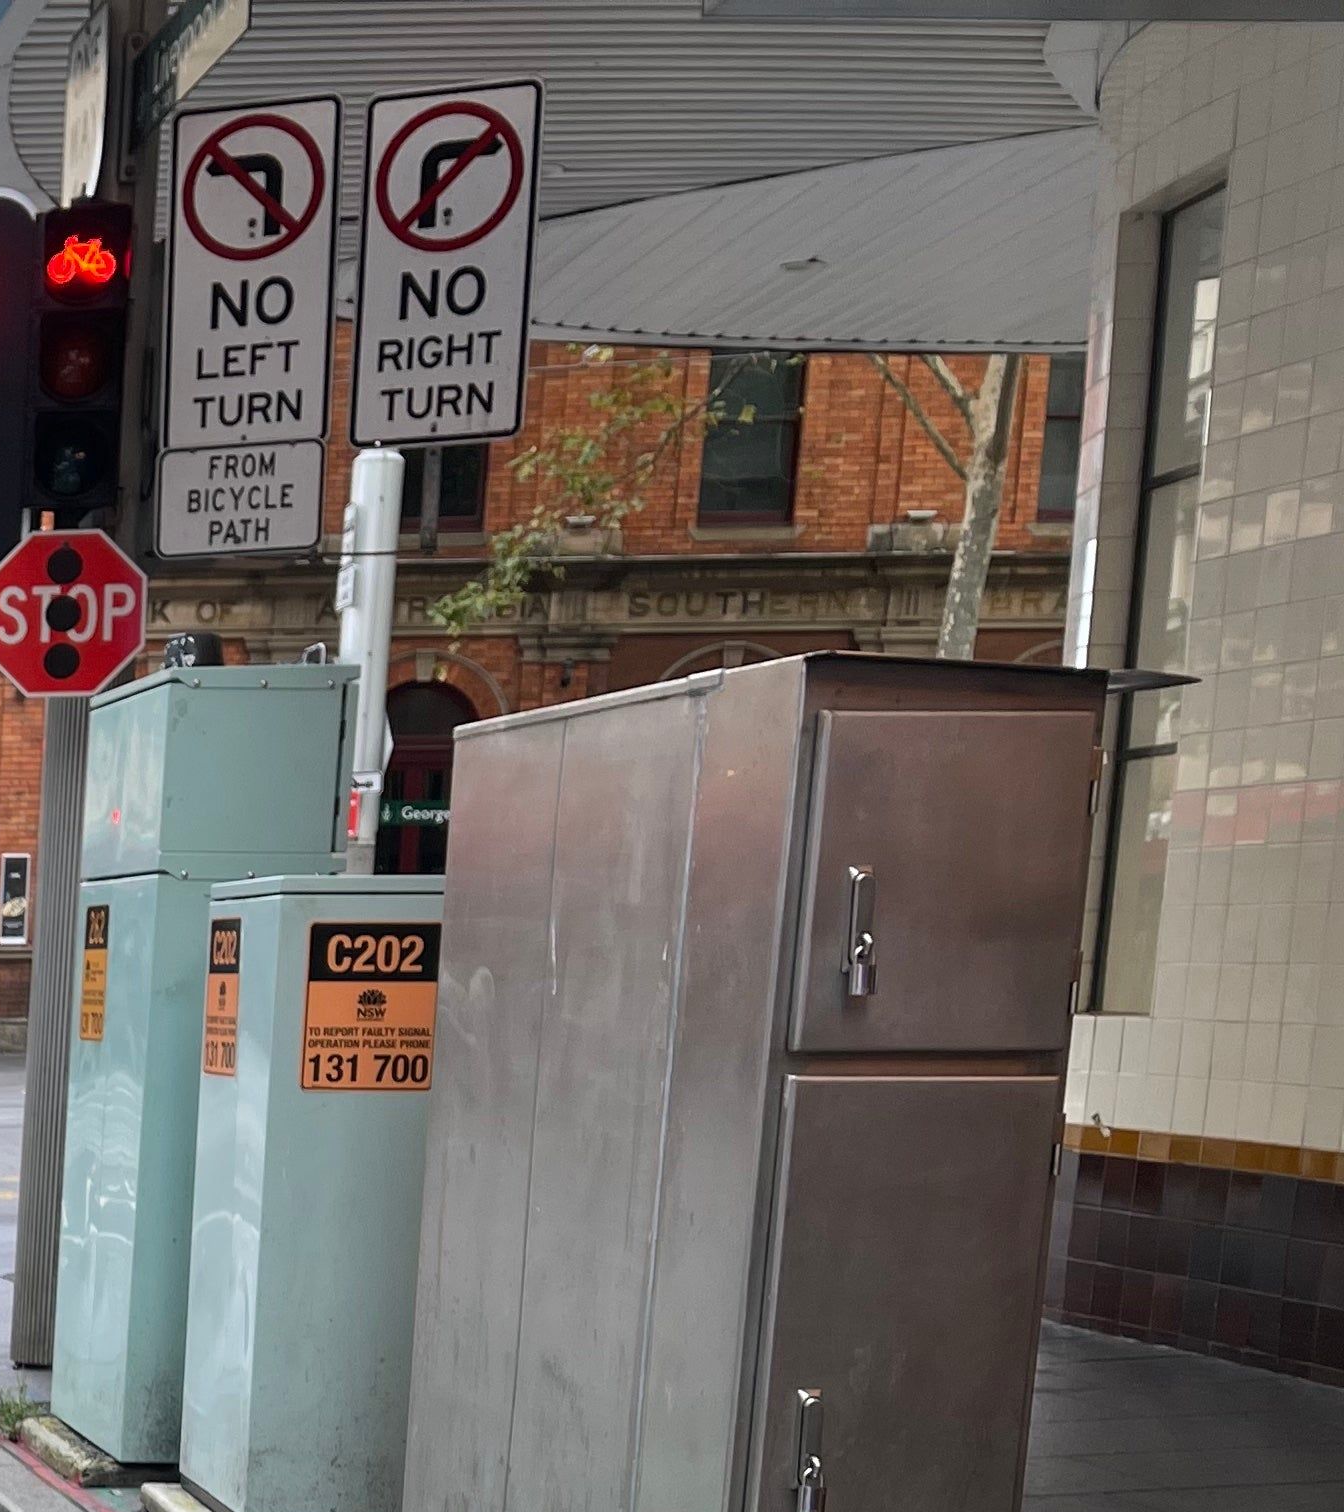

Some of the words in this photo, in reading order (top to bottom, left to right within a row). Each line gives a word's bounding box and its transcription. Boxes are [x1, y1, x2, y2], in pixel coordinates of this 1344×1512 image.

[210, 276, 295, 330] NO
[398, 265, 487, 320] NO
[196, 340, 300, 380] LEFT
[377, 330, 502, 373] RIGHT
[194, 390, 304, 429] TURN
[381, 382, 495, 421] TURN
[209, 452, 277, 480] FROM
[187, 485, 294, 515] BICYCLE
[209, 519, 271, 545] PATH
[401, 805, 451, 824] George
[327, 933, 425, 974] C202
[356, 1007, 387, 1019] NSW
[308, 1038, 360, 1049] OPERATION
[362, 1038, 398, 1049] PLEASE
[399, 1038, 432, 1049] PHONE
[309, 1027, 321, 1037] TO
[323, 1027, 360, 1037] REPORT
[362, 1027, 396, 1037] FAULTY
[398, 1027, 433, 1037] SIGNAL
[308, 1053, 359, 1083] 131
[373, 1053, 430, 1083] 700
